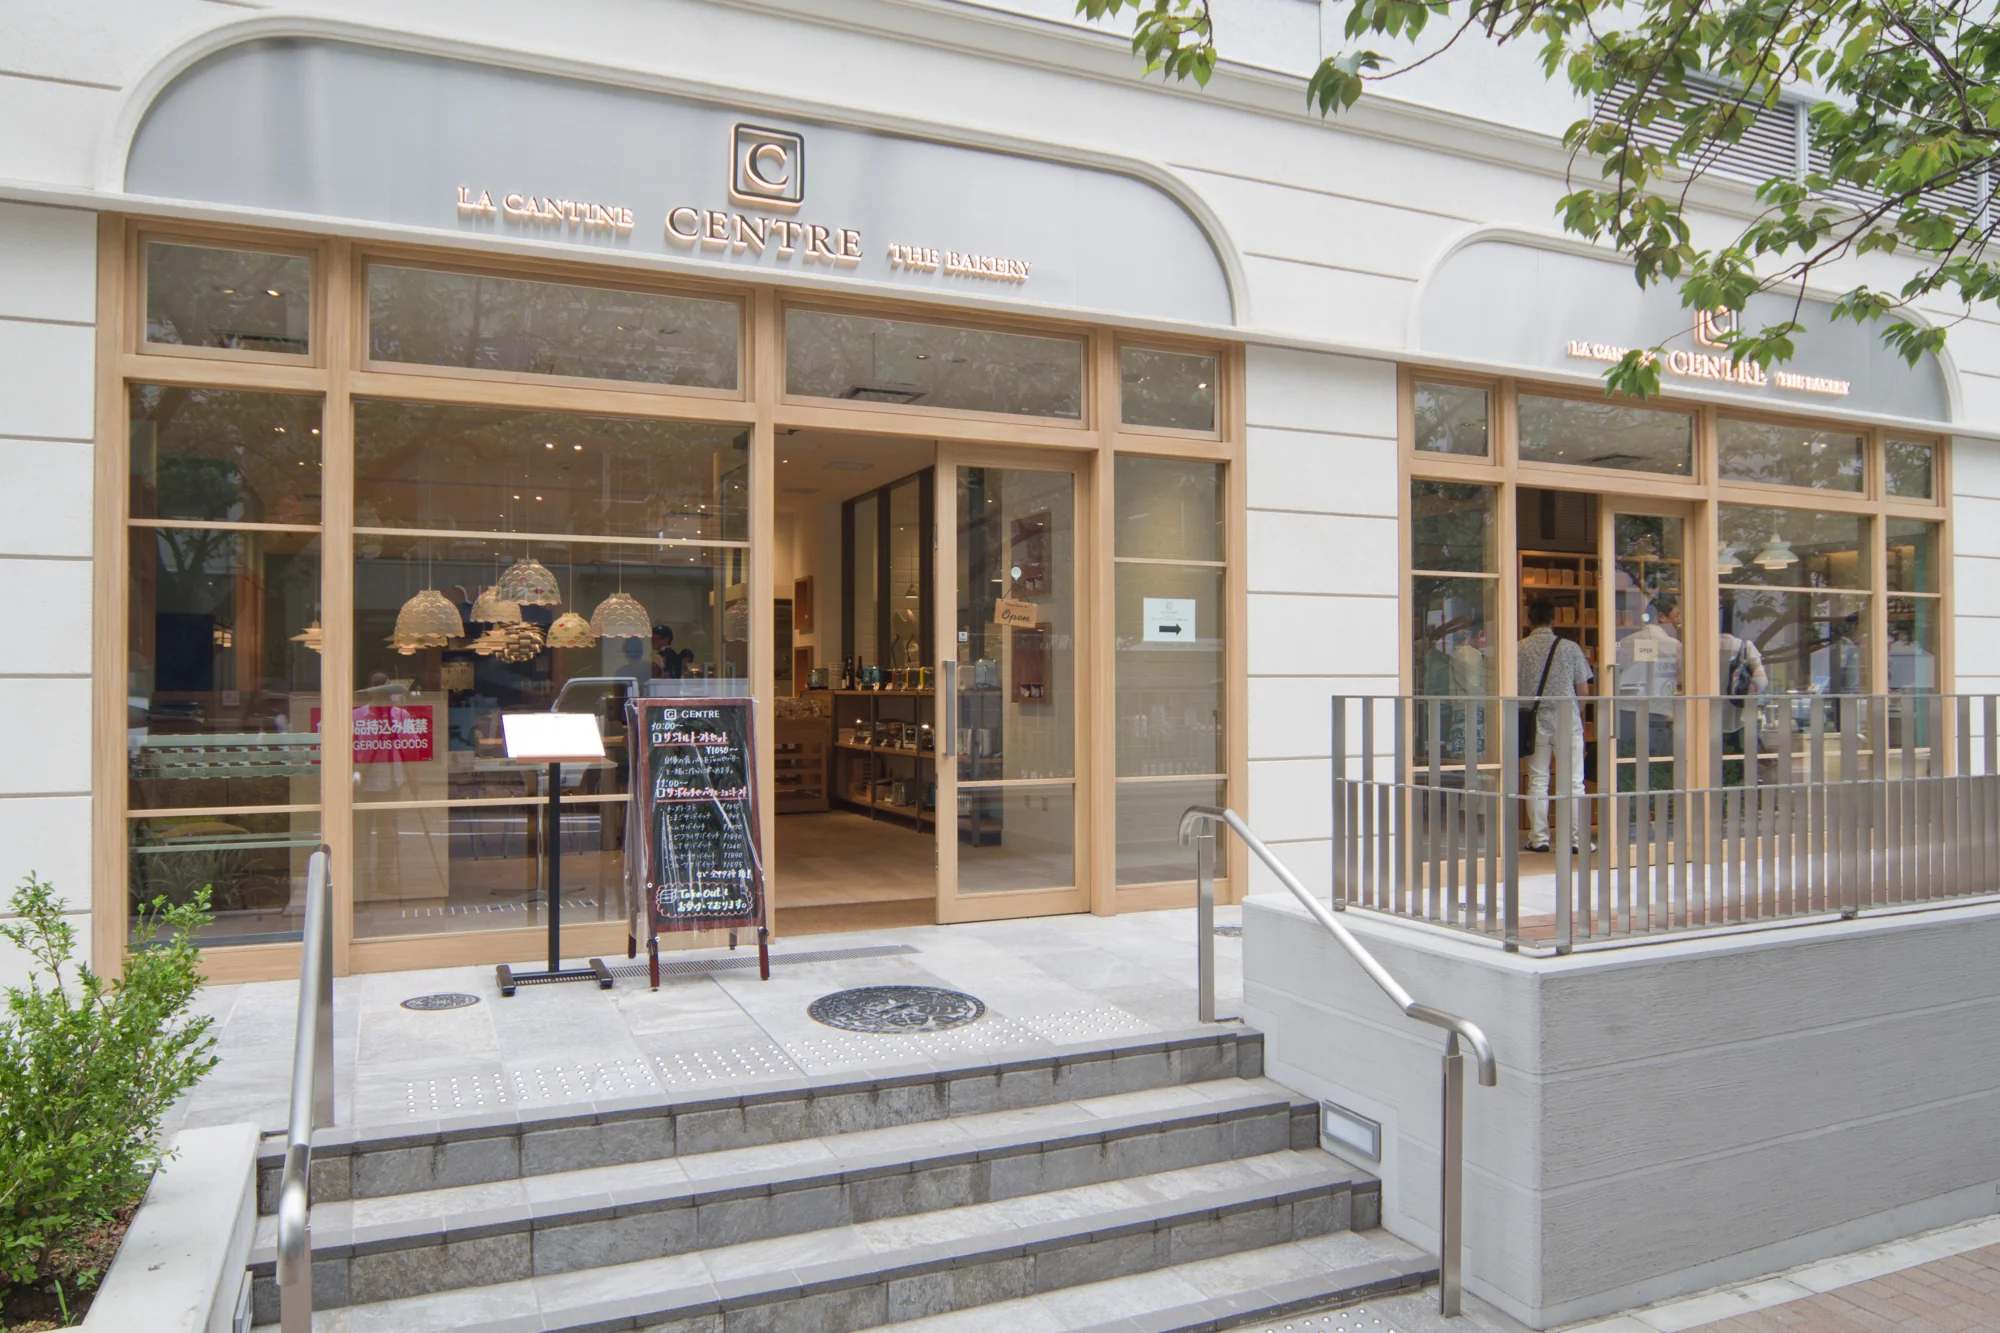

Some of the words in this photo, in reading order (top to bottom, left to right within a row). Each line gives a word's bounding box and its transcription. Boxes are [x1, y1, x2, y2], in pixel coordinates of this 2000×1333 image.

[745, 142, 789, 189] C
[457, 186, 497, 212] LA
[502, 194, 635, 228] CANTINE
[666, 206, 863, 262] CENTRE
[889, 243, 940, 267] THE
[944, 251, 1032, 279] BAKERY
[1002, 610, 1031, 623] Open
[681, 710, 720, 718] CENTRE
[316, 719, 428, 735] 品持込み厳禁
[393, 739, 428, 749] GOODS
